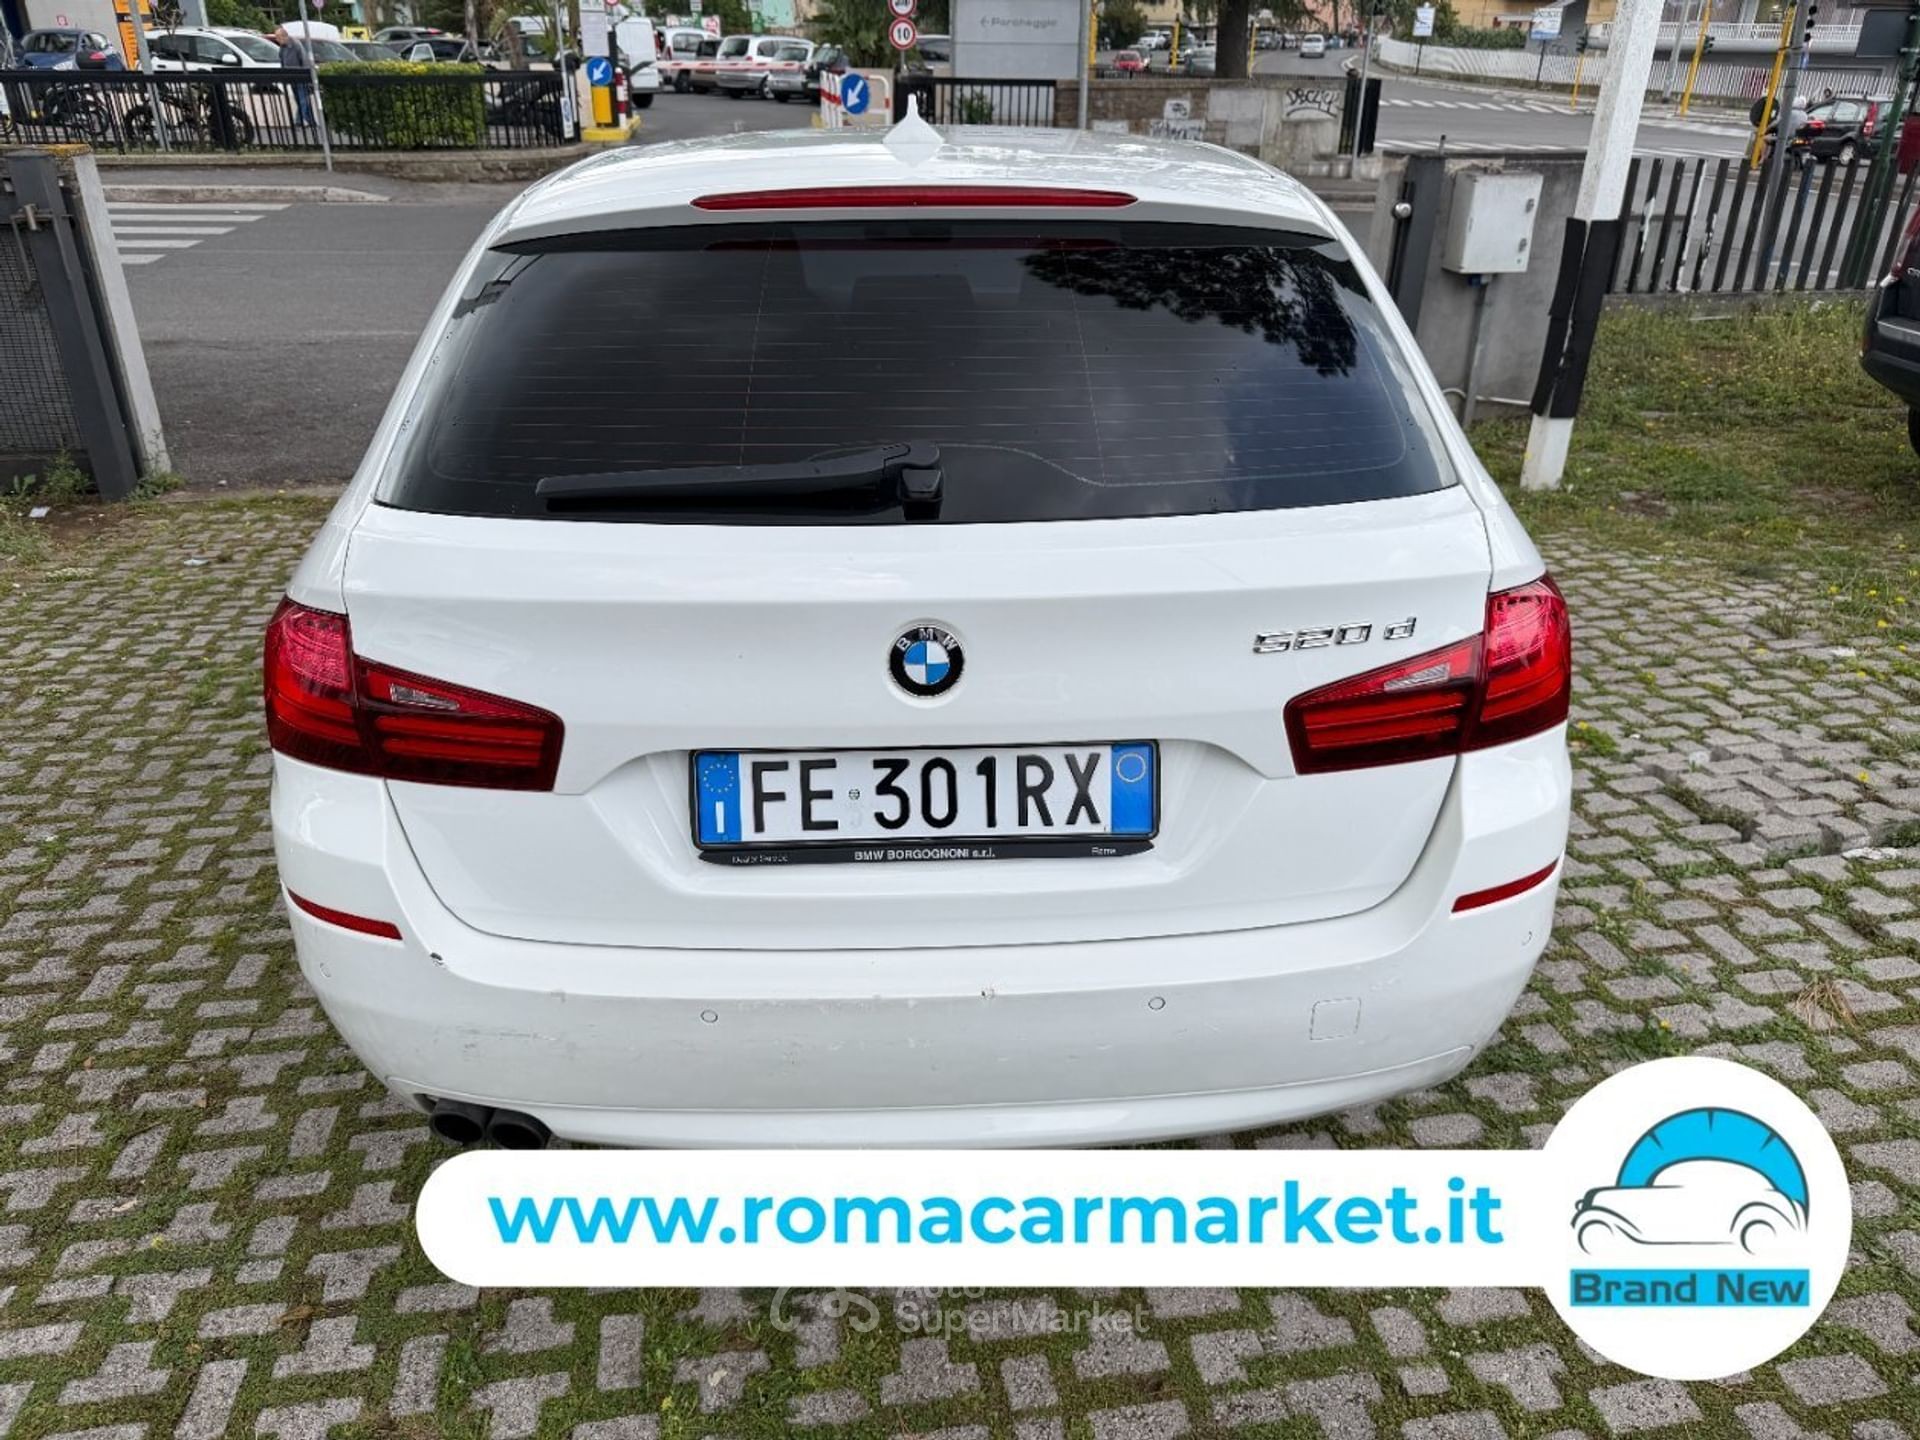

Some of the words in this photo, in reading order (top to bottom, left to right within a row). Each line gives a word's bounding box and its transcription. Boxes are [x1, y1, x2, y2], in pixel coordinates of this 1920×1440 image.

[897, 27, 911, 41] 10
[896, 628, 958, 652] BMW
[1253, 621, 1372, 654] 520
[1383, 616, 1417, 640] d
[752, 758, 839, 833] FE
[872, 753, 1102, 830] 301RX
[854, 850, 884, 861] BMW
[887, 848, 969, 860] BORGOGNONI
